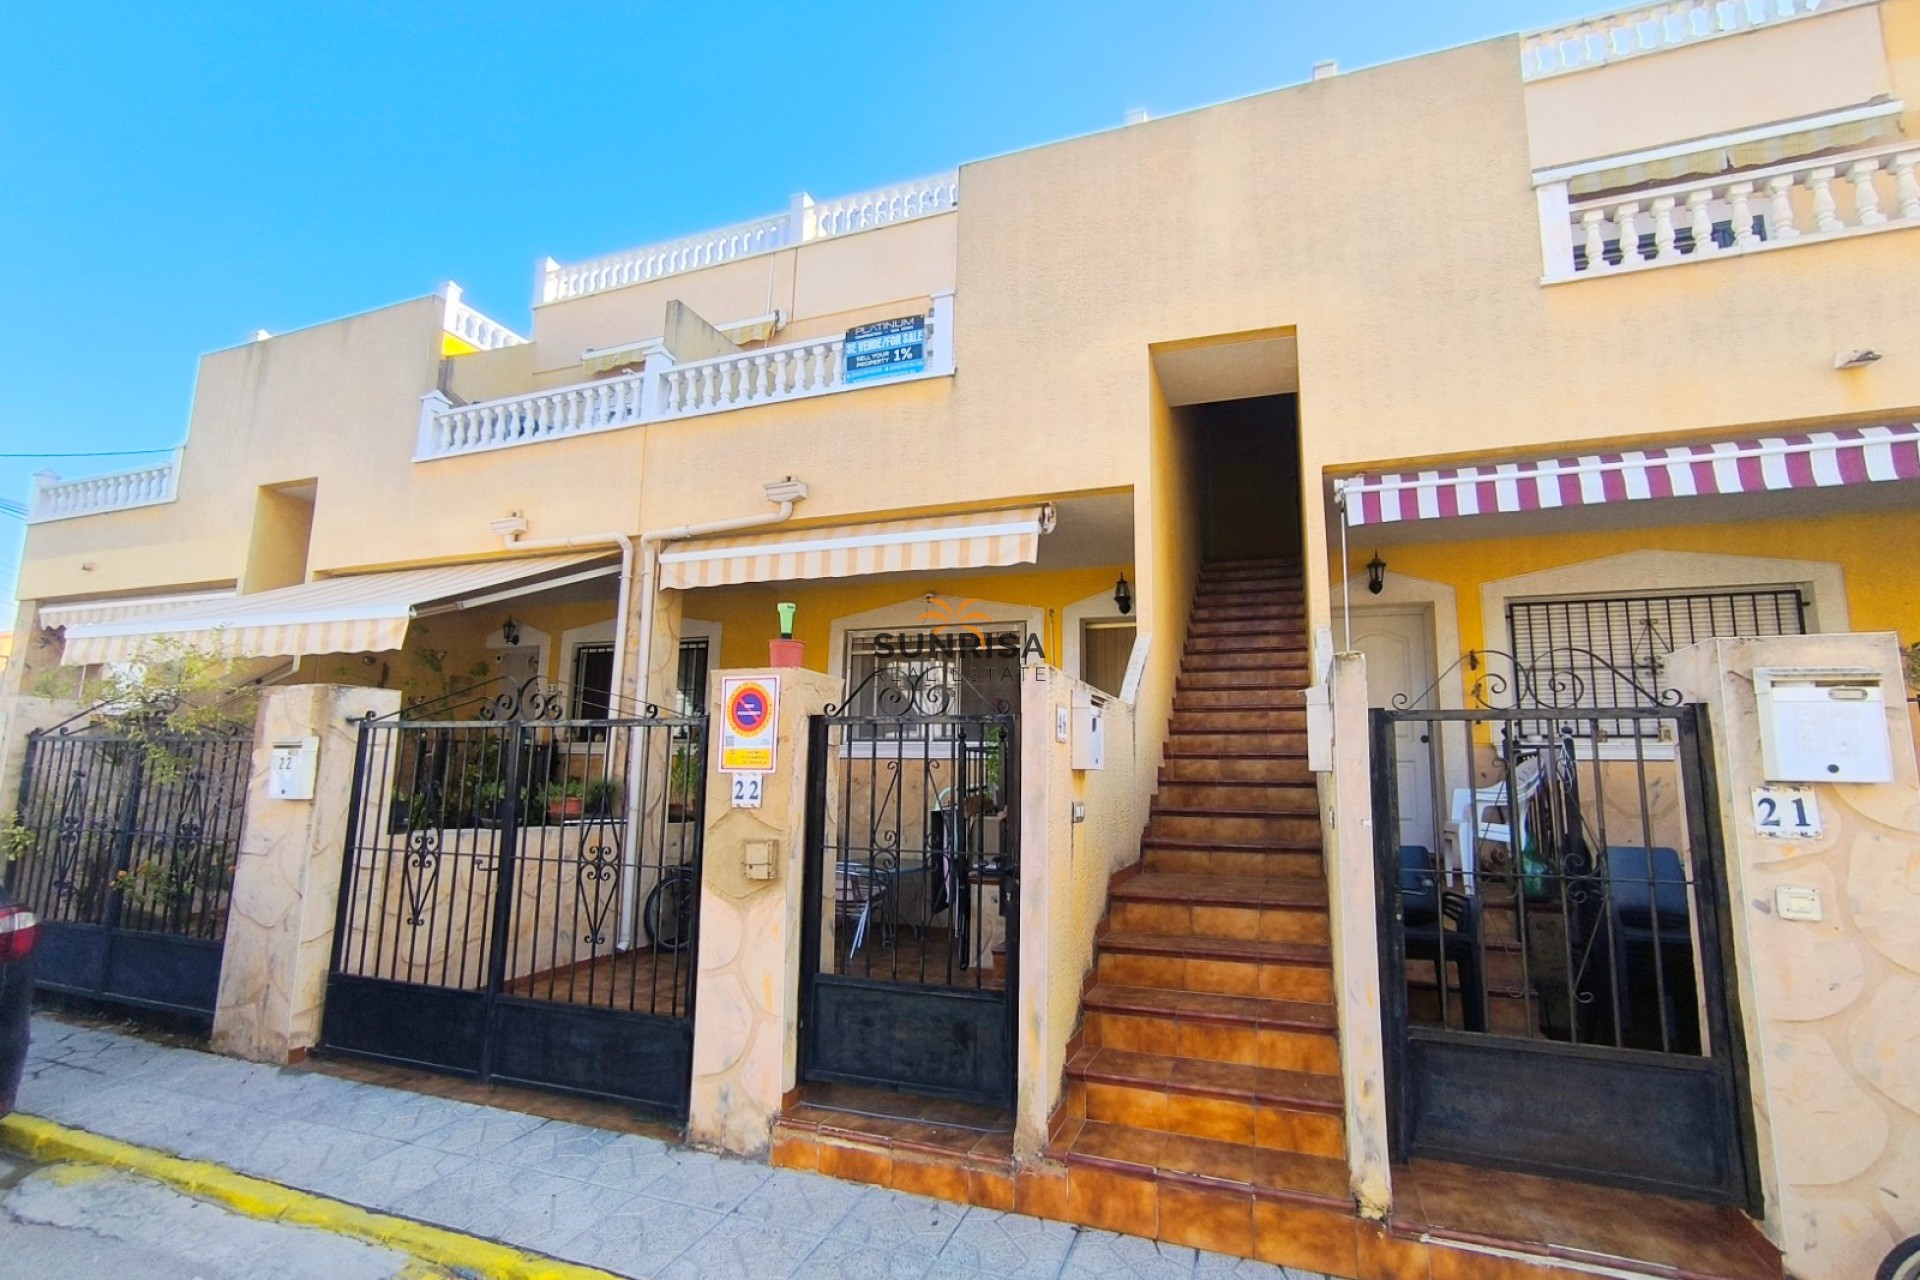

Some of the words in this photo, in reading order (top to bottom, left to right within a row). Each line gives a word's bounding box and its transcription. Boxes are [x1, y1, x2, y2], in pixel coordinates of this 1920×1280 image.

[855, 318, 915, 335] PLATINUM
[903, 330, 924, 344] SALE
[893, 347, 913, 362] 1%
[279, 757, 292, 770] 22
[734, 780, 759, 800] 22
[1757, 797, 1812, 827] 21
